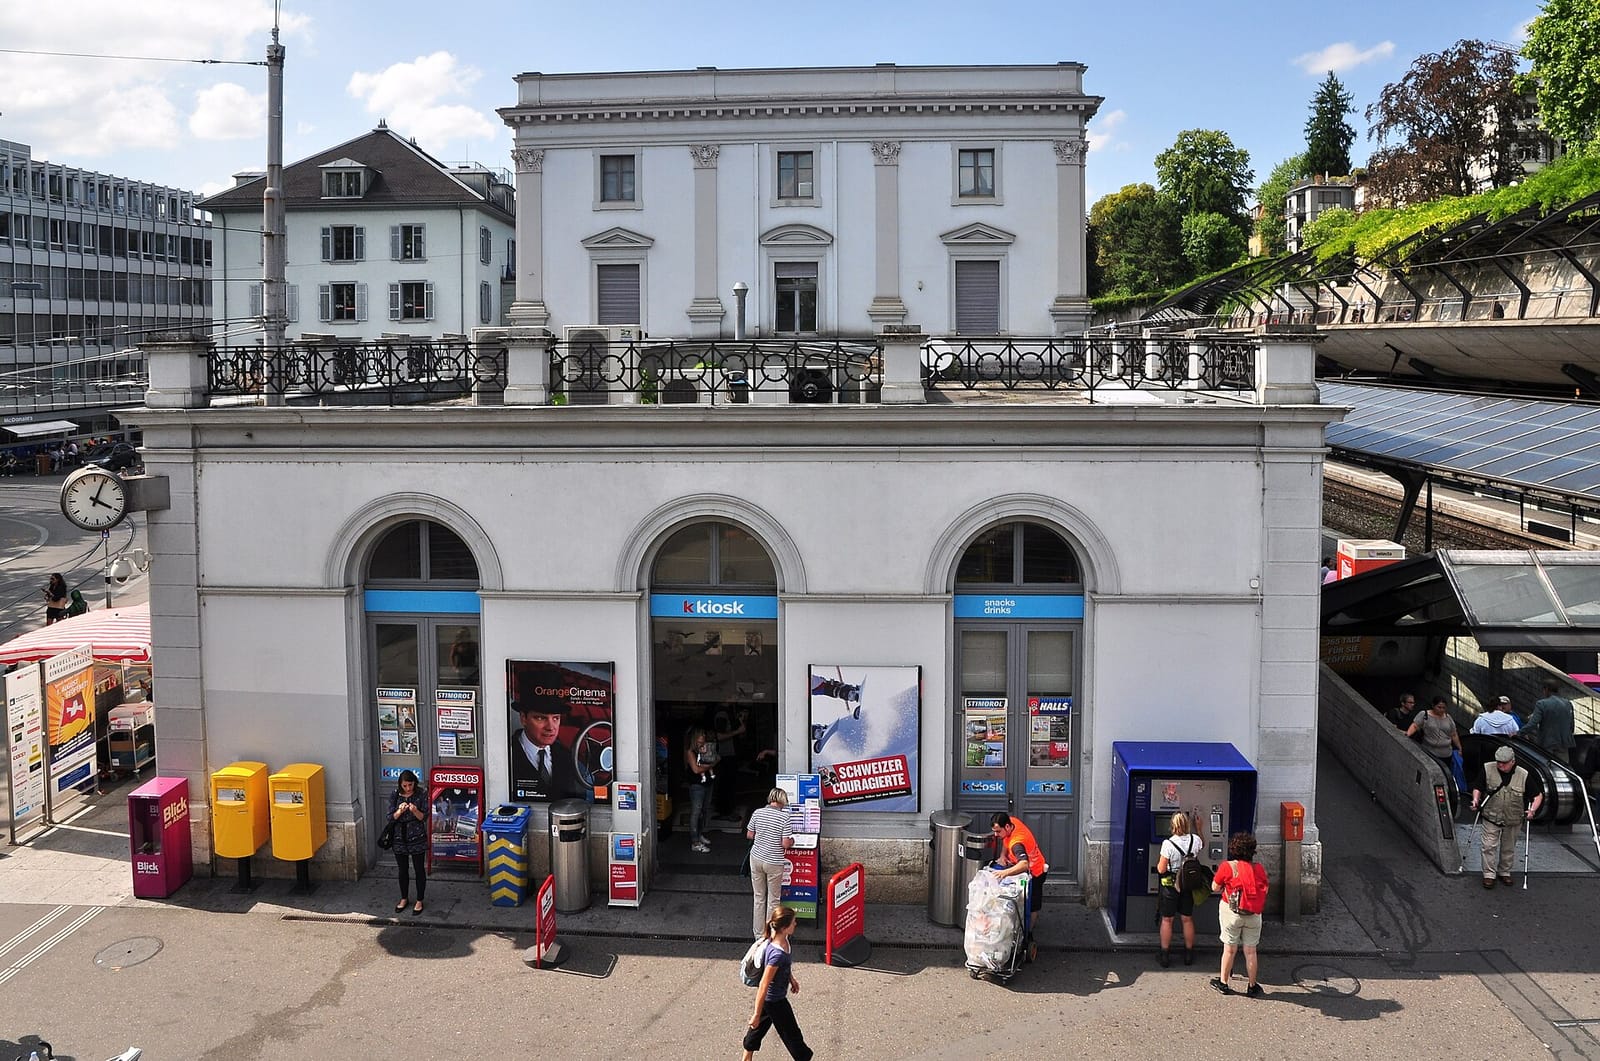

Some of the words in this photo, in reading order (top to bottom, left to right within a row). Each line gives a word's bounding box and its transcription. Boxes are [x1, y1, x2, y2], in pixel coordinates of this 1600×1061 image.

[696, 600, 744, 614] kiosk
[984, 598, 1016, 607] snacks
[984, 606, 1012, 614] drinks
[1039, 702, 1069, 711] HALLS
[839, 759, 903, 779] SCHWEIZER
[434, 773, 479, 784] SWISSLOS
[832, 773, 906, 794] COURAGIERTE
[163, 797, 187, 823] Blick
[136, 861, 159, 871] Blick
